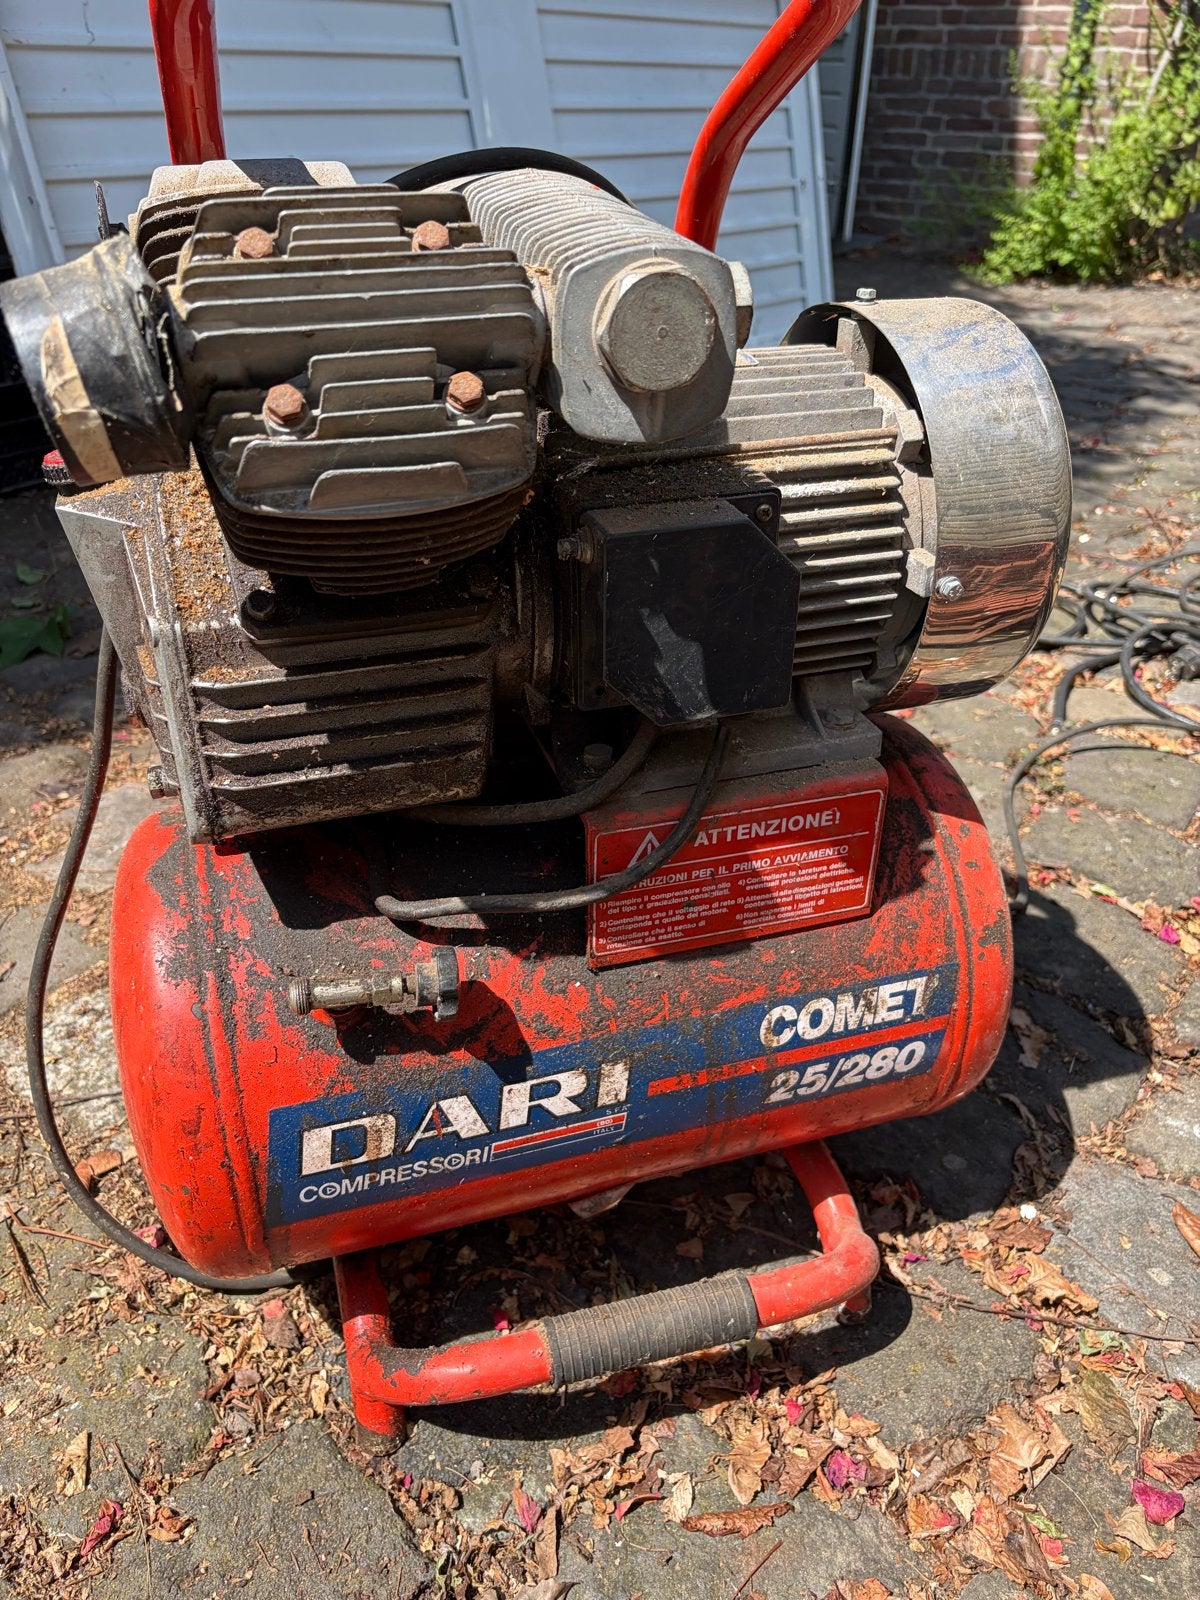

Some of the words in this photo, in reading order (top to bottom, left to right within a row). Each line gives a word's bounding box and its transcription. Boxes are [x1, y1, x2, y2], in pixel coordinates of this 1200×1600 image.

[694, 811, 841, 846] ATTENZIONE!
[639, 872, 687, 888] RUZIONI
[692, 870, 714, 879] PER
[719, 866, 728, 874] IL
[733, 859, 770, 872] PRIMO
[774, 845, 848, 865] AVVIAMENTO
[746, 872, 787, 883] Controllare
[798, 865, 827, 875] taratura
[745, 891, 779, 902] Attenersi
[793, 881, 835, 894] disposizioni
[835, 876, 864, 886] generali
[746, 880, 779, 890] eventuali
[781, 874, 817, 885] protezioni
[608, 897, 642, 907] Riempire
[651, 888, 700, 900] compressore
[744, 898, 781, 909] contenute
[795, 891, 820, 899] libretto
[608, 914, 650, 926] Controllare
[652, 910, 666, 918] che
[675, 905, 709, 914] voltaggio
[622, 905, 637, 913] tipo
[607, 921, 652, 932] corrisponda
[662, 915, 684, 924] quello
[607, 930, 649, 942] Controllare
[651, 927, 665, 935] che
[674, 923, 696, 931] senso
[607, 939, 642, 950] rotazione
[760, 974, 939, 1048] COMET
[763, 1041, 926, 1104] 25/280
[301, 1059, 631, 1178] DARI
[300, 1146, 490, 1202] COMPRESSORI
